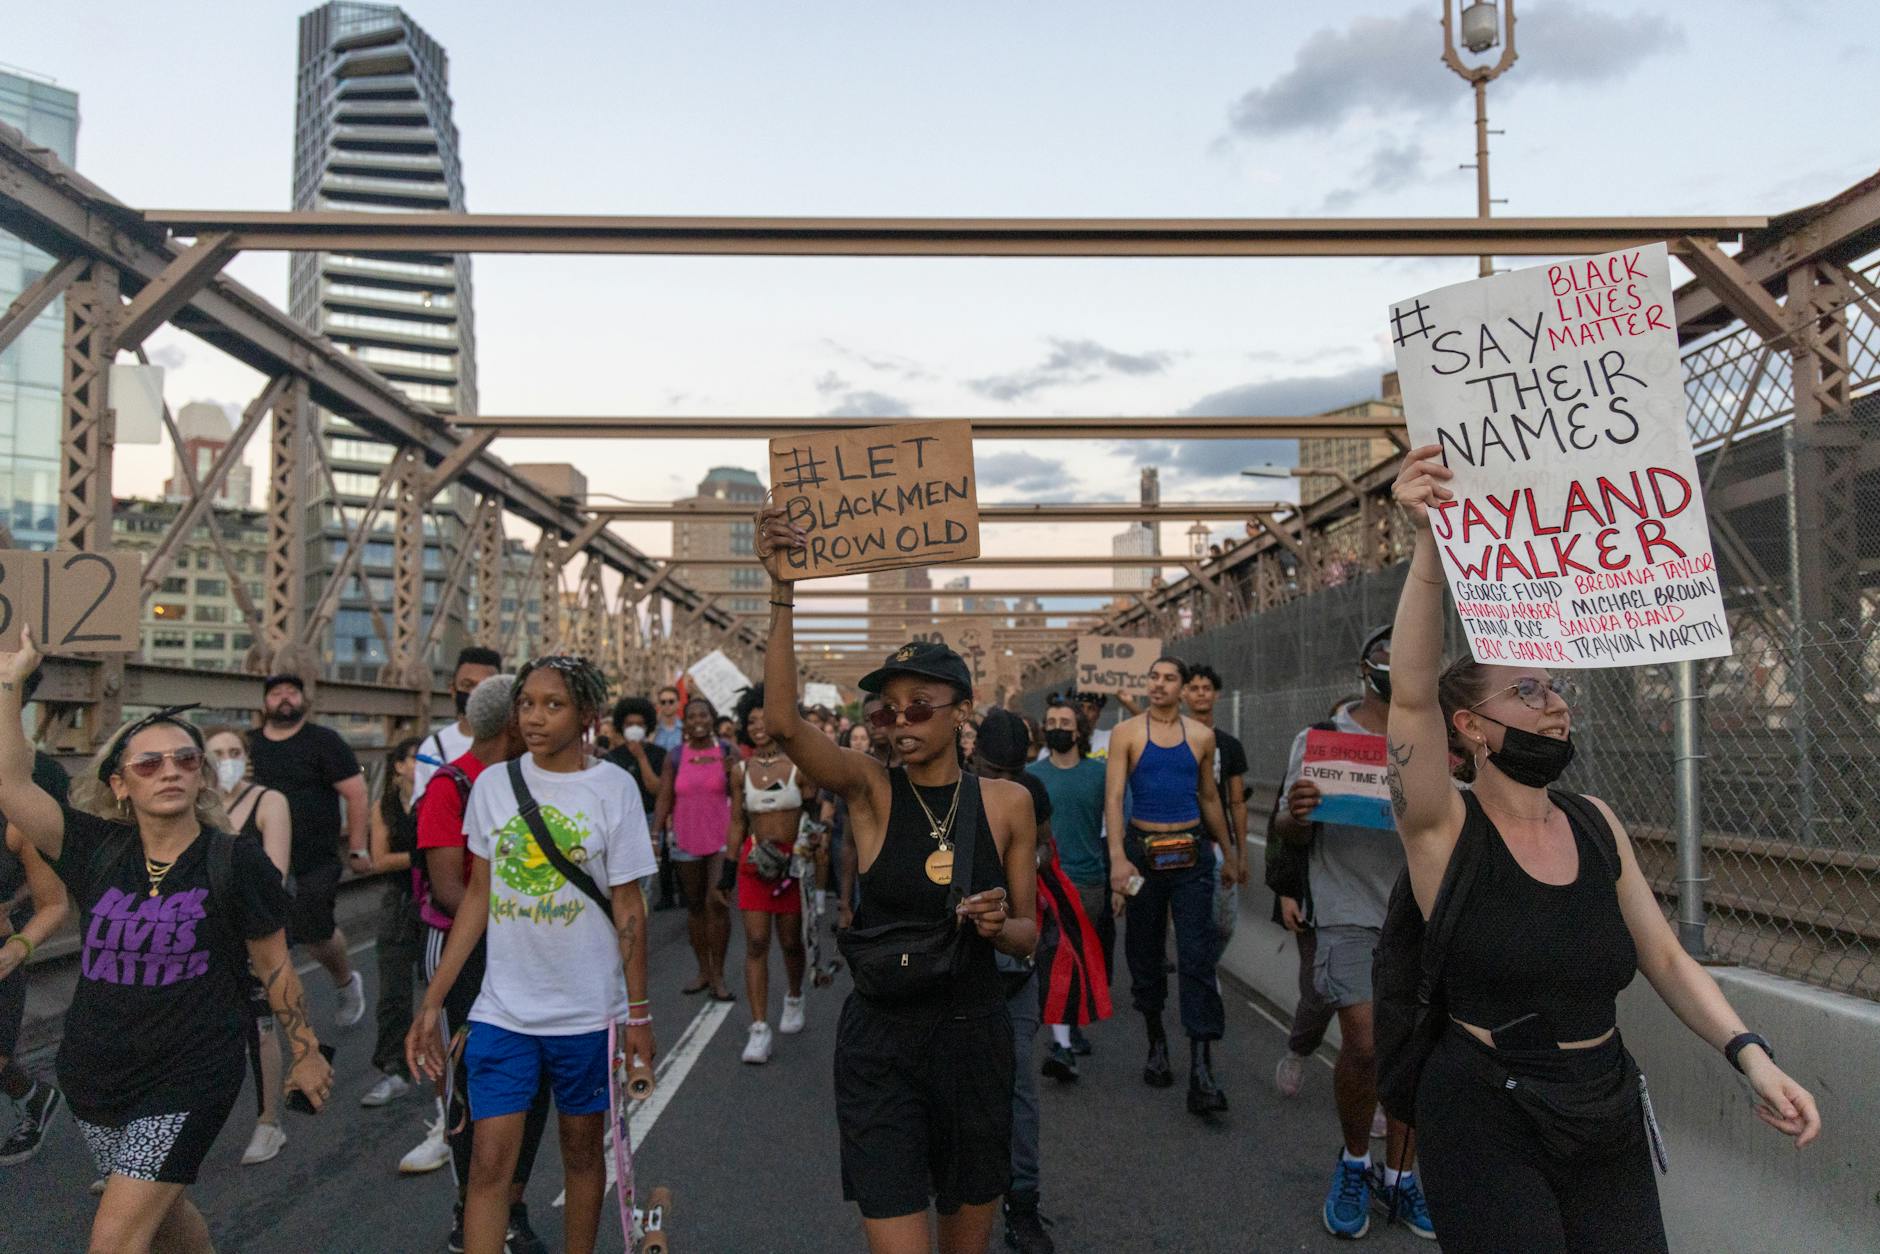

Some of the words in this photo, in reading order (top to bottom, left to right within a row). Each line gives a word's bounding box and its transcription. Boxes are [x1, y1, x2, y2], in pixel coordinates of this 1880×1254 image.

[1548, 252, 1648, 297] BLACK
[1557, 284, 1642, 322] LIVES
[1547, 305, 1671, 351] MATTER
[1465, 350, 1648, 413] THEIR
[1437, 396, 1639, 469] NAMES
[783, 436, 939, 493] #LET
[785, 488, 897, 535] BLACK
[897, 476, 968, 516] MEN
[1435, 467, 1692, 544] JAYLAND
[786, 528, 886, 570] GROW
[896, 520, 968, 552] OLD
[1445, 519, 1687, 581] WALKER
[1457, 581, 1512, 601] GEORGE
[1574, 567, 1655, 595] BREONNA
[1656, 552, 1716, 580] TAYLOR
[1458, 601, 1510, 620] AHMAUD
[1511, 600, 1561, 621] ARBERY
[1572, 590, 1652, 618] MICHAEL
[1654, 576, 1717, 607] BROWN
[1465, 618, 1516, 638] TAMIR
[1514, 620, 1549, 639] RICE
[1559, 613, 1622, 637] SANDRA
[1624, 605, 1686, 630] BLAND
[1568, 629, 1645, 663] TRAYVON
[1649, 613, 1724, 652] MARTIN
[1101, 643, 1135, 659] NO
[1475, 637, 1508, 660] ERIC
[1509, 640, 1574, 663] GARNER
[1081, 664, 1148, 689] JUSTIC
[1330, 745, 1384, 761] SHOULD
[1303, 766, 1343, 780] EVERY
[1349, 771, 1377, 785] TIME
[85, 914, 198, 955] LIVES
